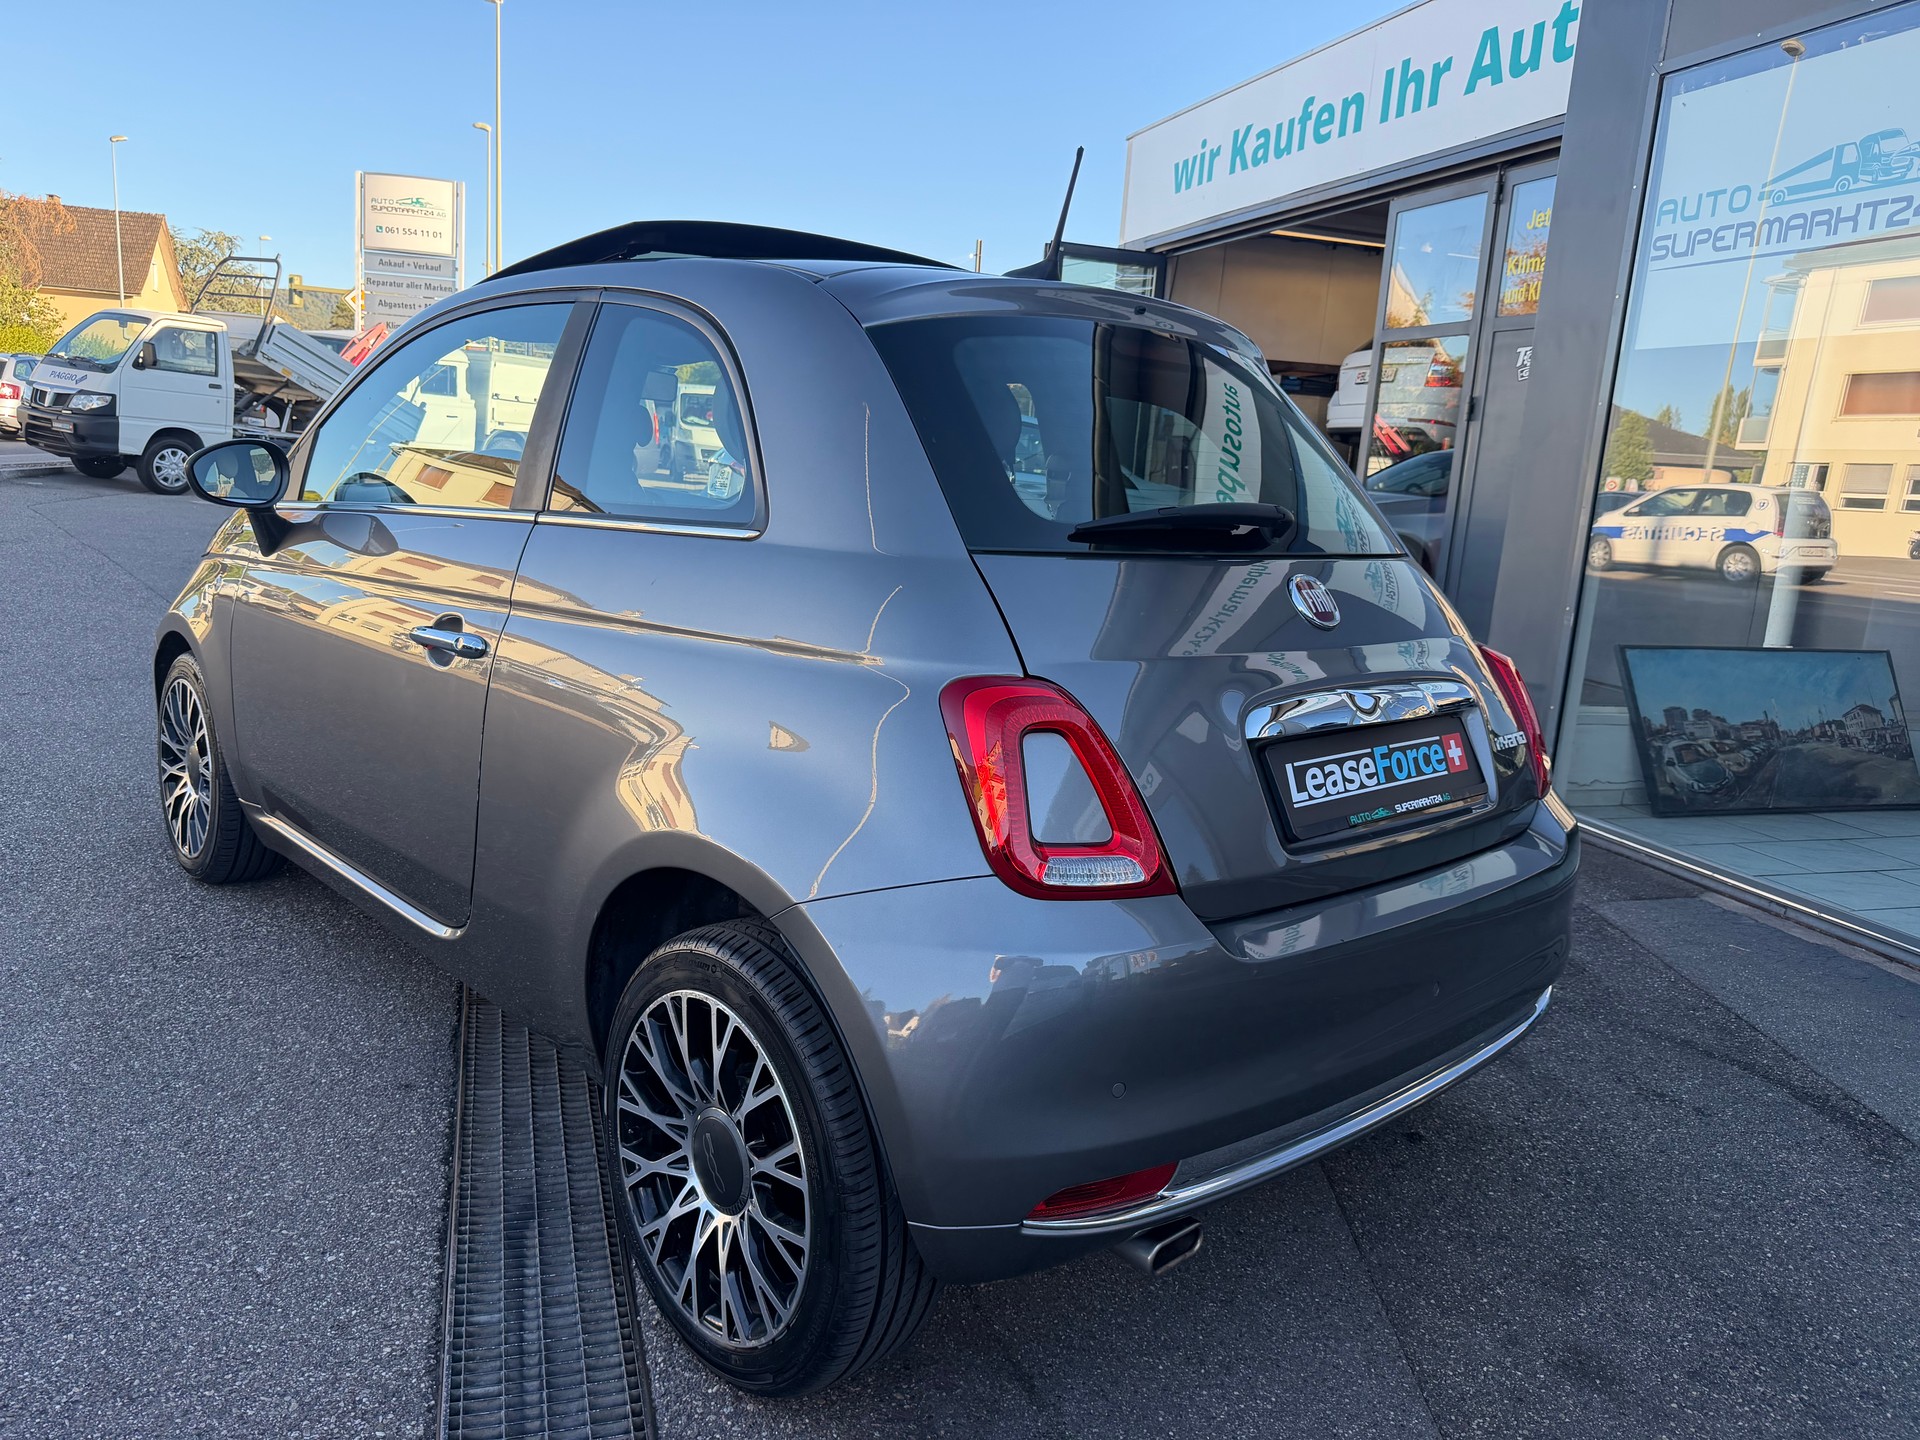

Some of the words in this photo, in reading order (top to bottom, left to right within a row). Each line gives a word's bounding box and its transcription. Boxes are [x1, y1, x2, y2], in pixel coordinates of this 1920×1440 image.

[1172, 139, 1222, 194] wir
[1228, 95, 1365, 176] Kaufen
[1379, 55, 1453, 125] Ihr
[1463, 0, 1580, 96] Aut
[370, 197, 395, 205] AUTO
[1656, 184, 1752, 227] AUTO
[385, 226, 400, 234] 061
[402, 227, 418, 236] 554
[420, 230, 430, 238] 11
[432, 231, 443, 239] 01
[1650, 194, 1920, 262] SUPERMARKT2
[378, 258, 405, 268] Ankauf
[413, 262, 442, 272] Verkauf
[366, 277, 404, 288] Reparatur
[406, 281, 422, 290] aller
[424, 282, 453, 293] Marken
[378, 299, 416, 310] Abgastest
[49, 370, 77, 381] PIAGGIO
[1284, 742, 1447, 803] LeaseForce
[1350, 813, 1372, 826] AUTO
[1394, 794, 1443, 813] SUPERMARKT24
